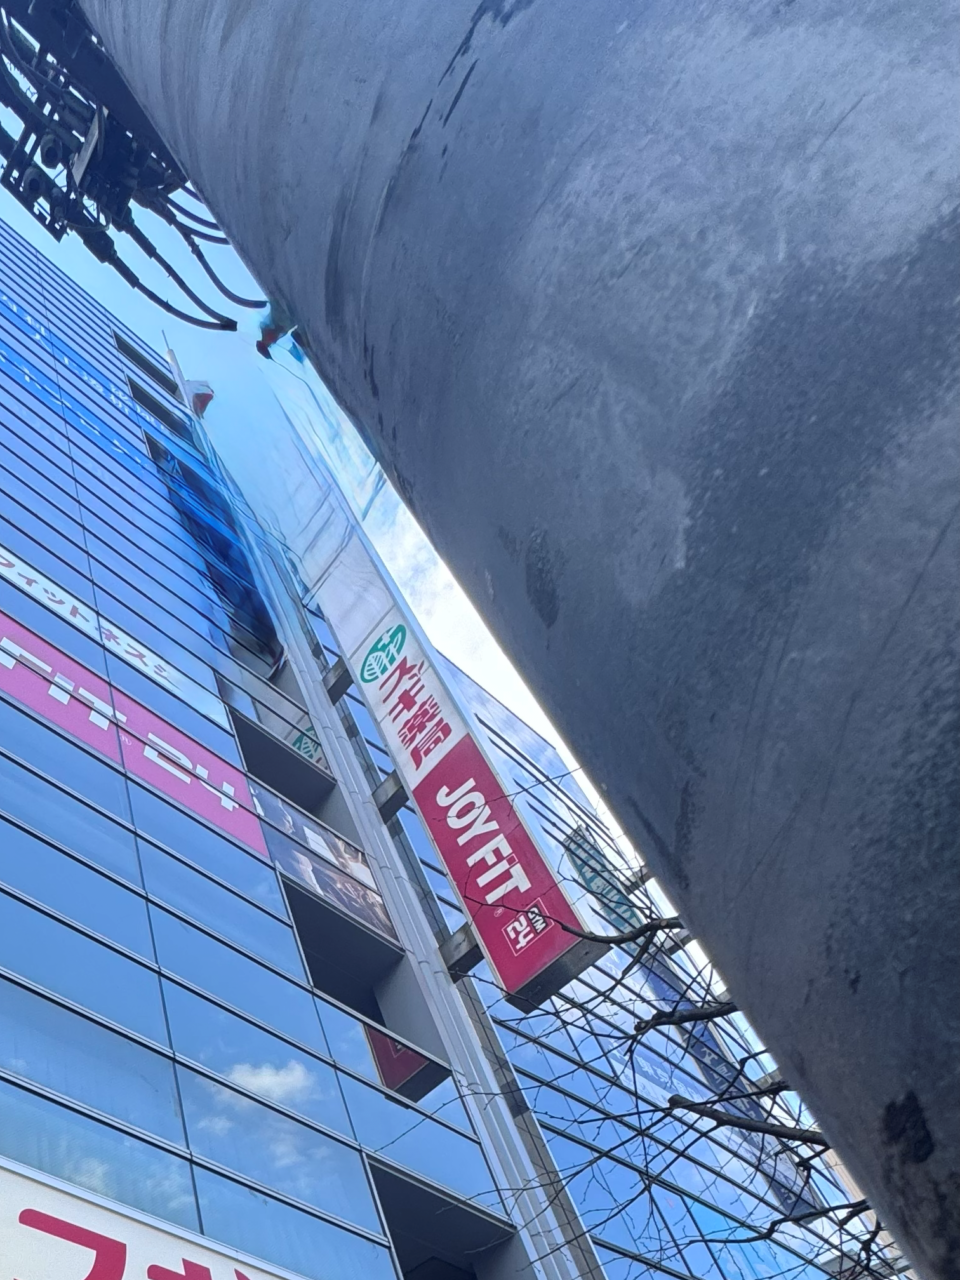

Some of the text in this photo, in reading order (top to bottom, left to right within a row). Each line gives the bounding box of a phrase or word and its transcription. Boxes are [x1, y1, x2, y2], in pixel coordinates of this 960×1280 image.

[377, 655, 453, 772] スギ薬局
[142, 732, 240, 813] 24
